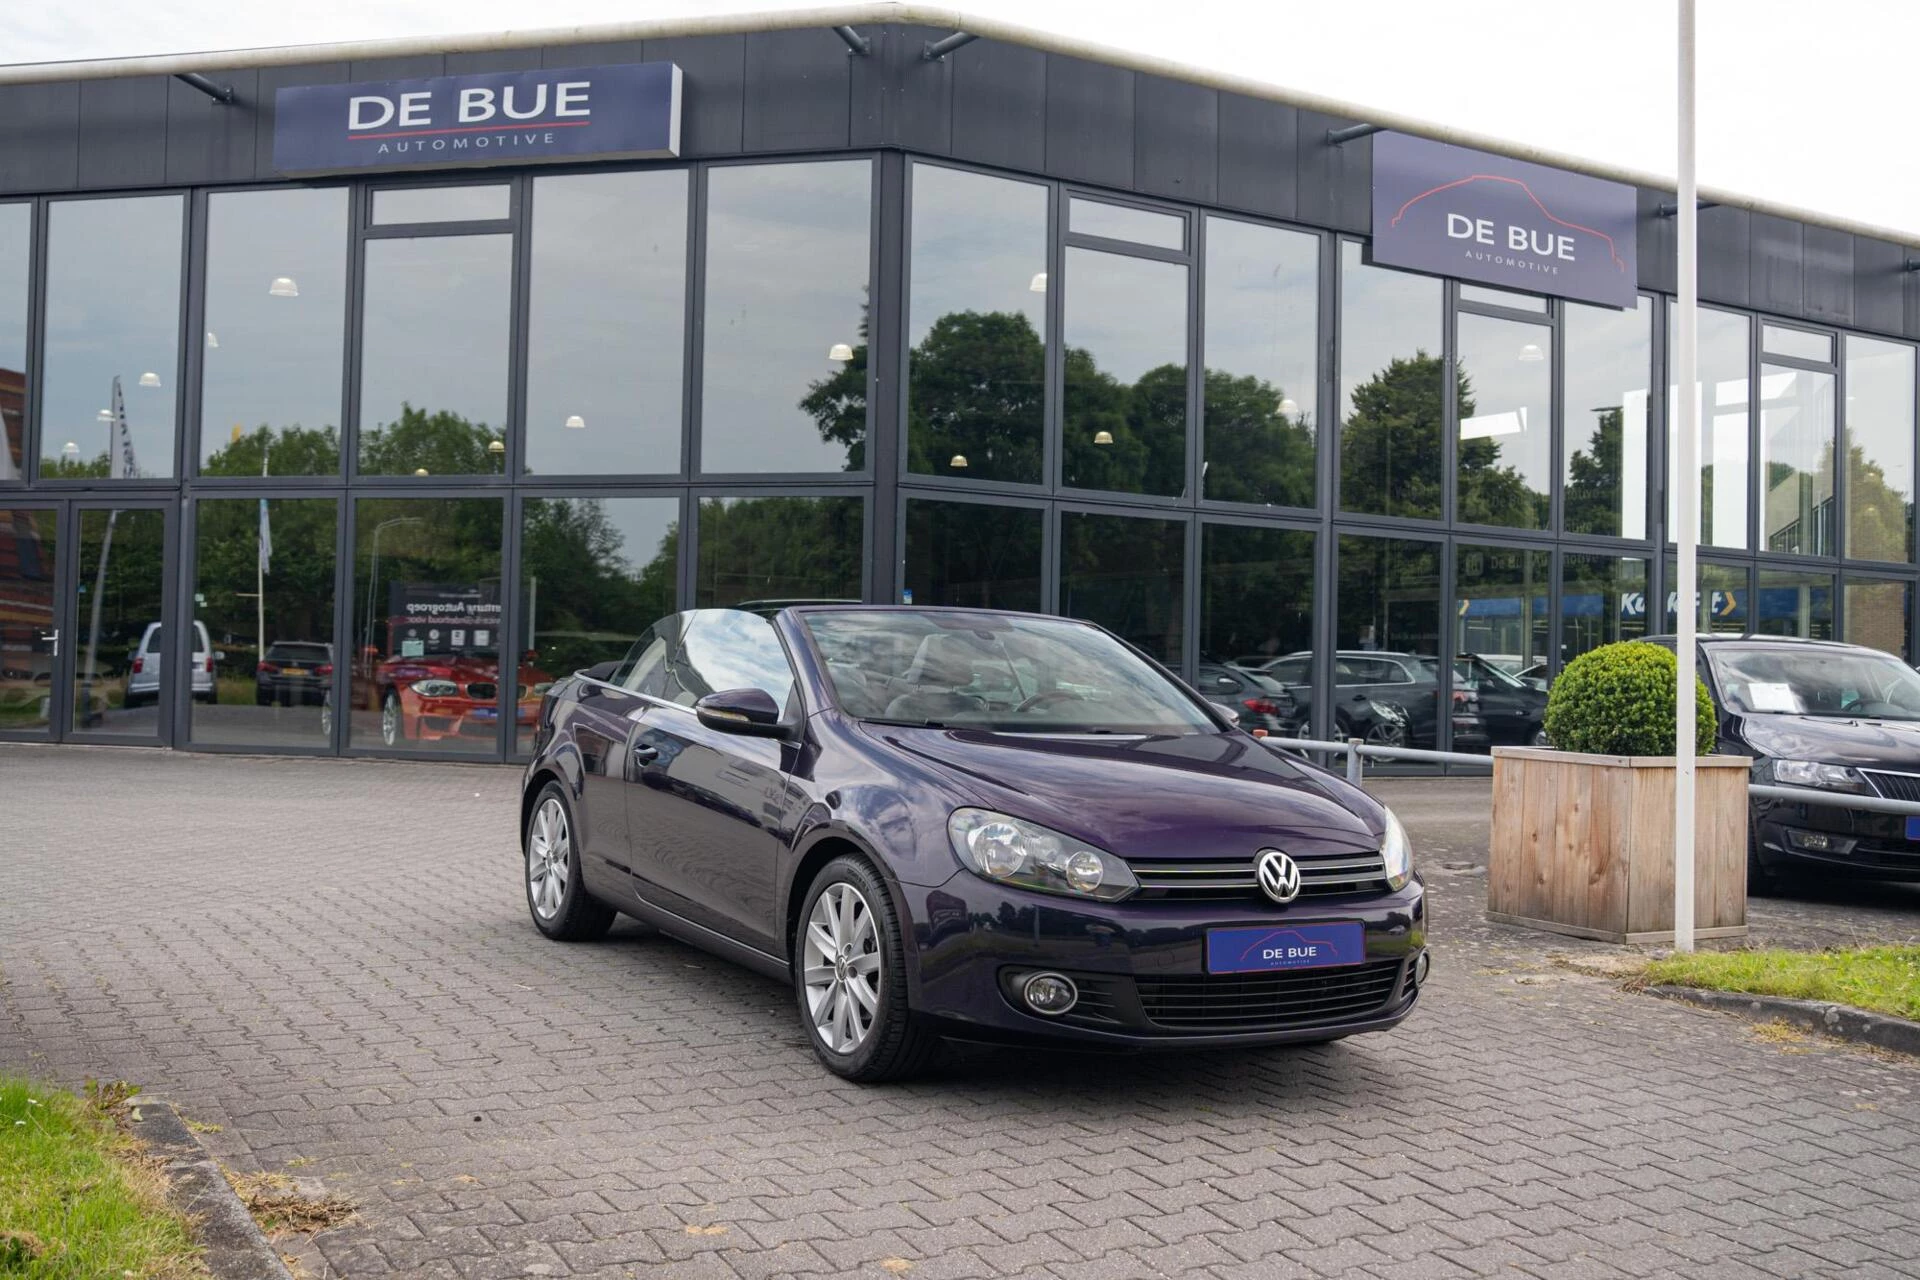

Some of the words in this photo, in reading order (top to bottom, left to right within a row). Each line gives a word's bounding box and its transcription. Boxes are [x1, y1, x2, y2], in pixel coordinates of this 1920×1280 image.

[348, 91, 432, 130] DE
[458, 81, 591, 123] BUE
[377, 132, 555, 155] AUTOMOTIVE
[1447, 213, 1495, 245] DE
[1508, 225, 1576, 261] BUE
[1465, 250, 1560, 275] AUTOMOTIVE
[1263, 949, 1283, 960] DE
[1288, 946, 1317, 958] BUE
